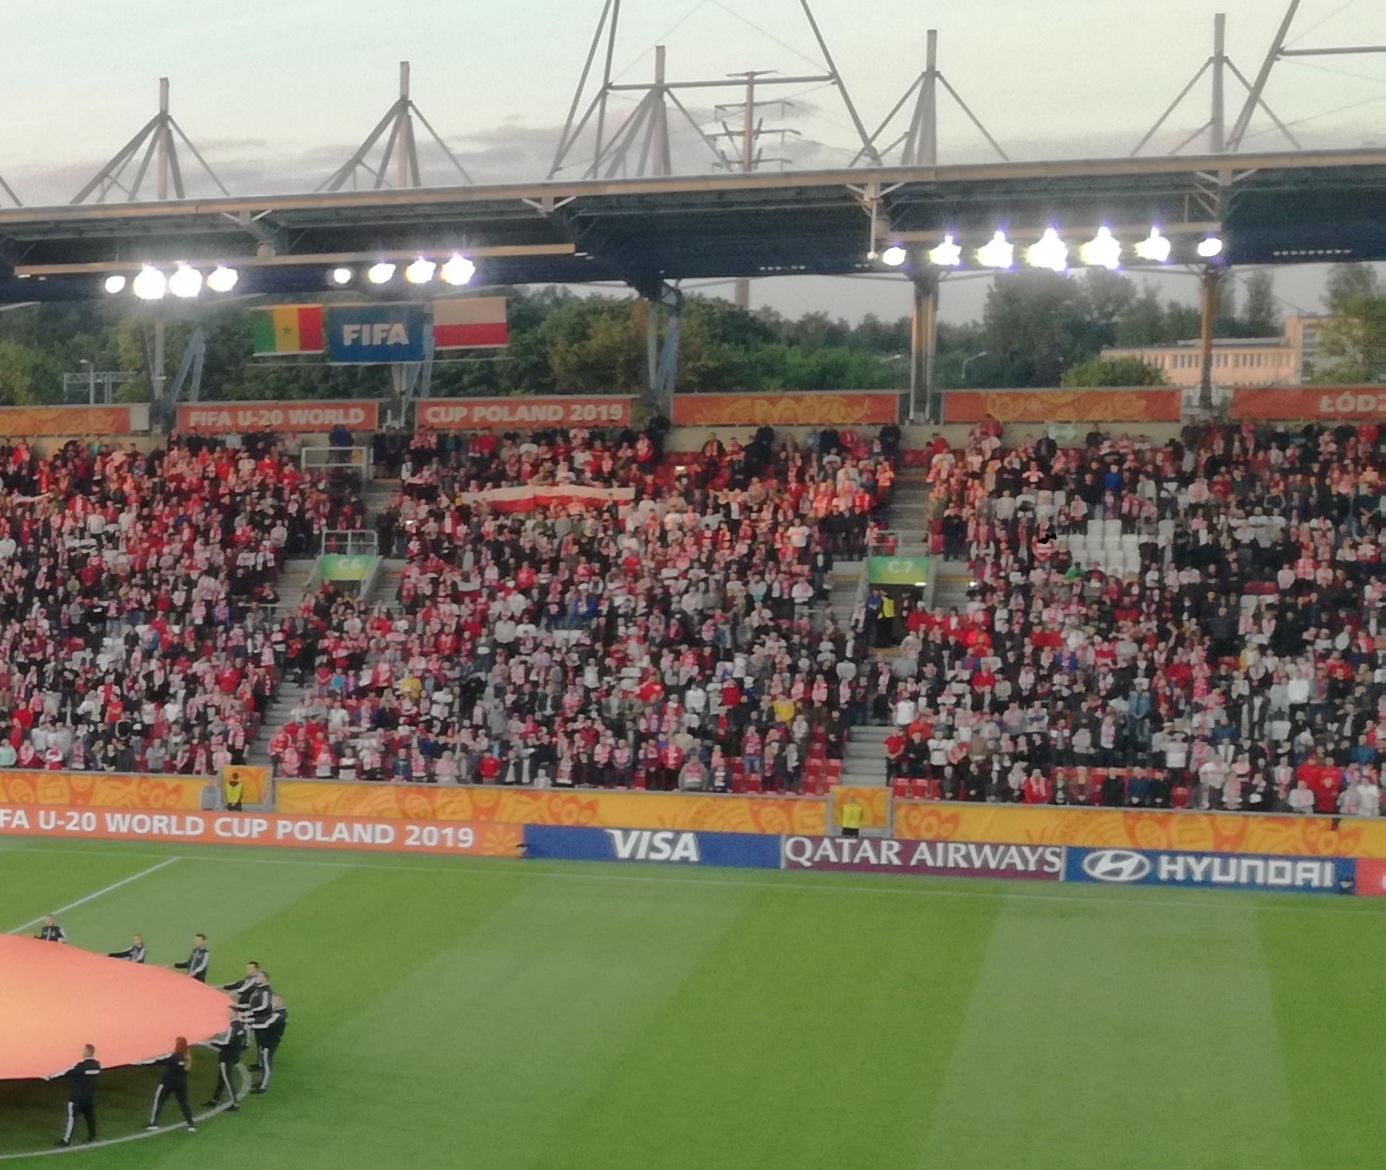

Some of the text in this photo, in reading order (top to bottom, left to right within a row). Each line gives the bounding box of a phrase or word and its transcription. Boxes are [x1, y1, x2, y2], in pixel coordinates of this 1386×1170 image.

[342, 323, 409, 346] FIFA
[189, 407, 365, 427] FIFA U-20 WORLD
[427, 404, 623, 424] CUP POLAND 2019
[37, 810, 97, 832] U-20
[105, 813, 204, 837] WORLD
[213, 816, 268, 839] CUP
[276, 820, 395, 845] POLAND
[404, 825, 474, 849] 2019
[604, 828, 700, 863] VISA
[784, 836, 1063, 873] QATAR AIRWAYS
[1158, 854, 1335, 888] HYUNDAI
